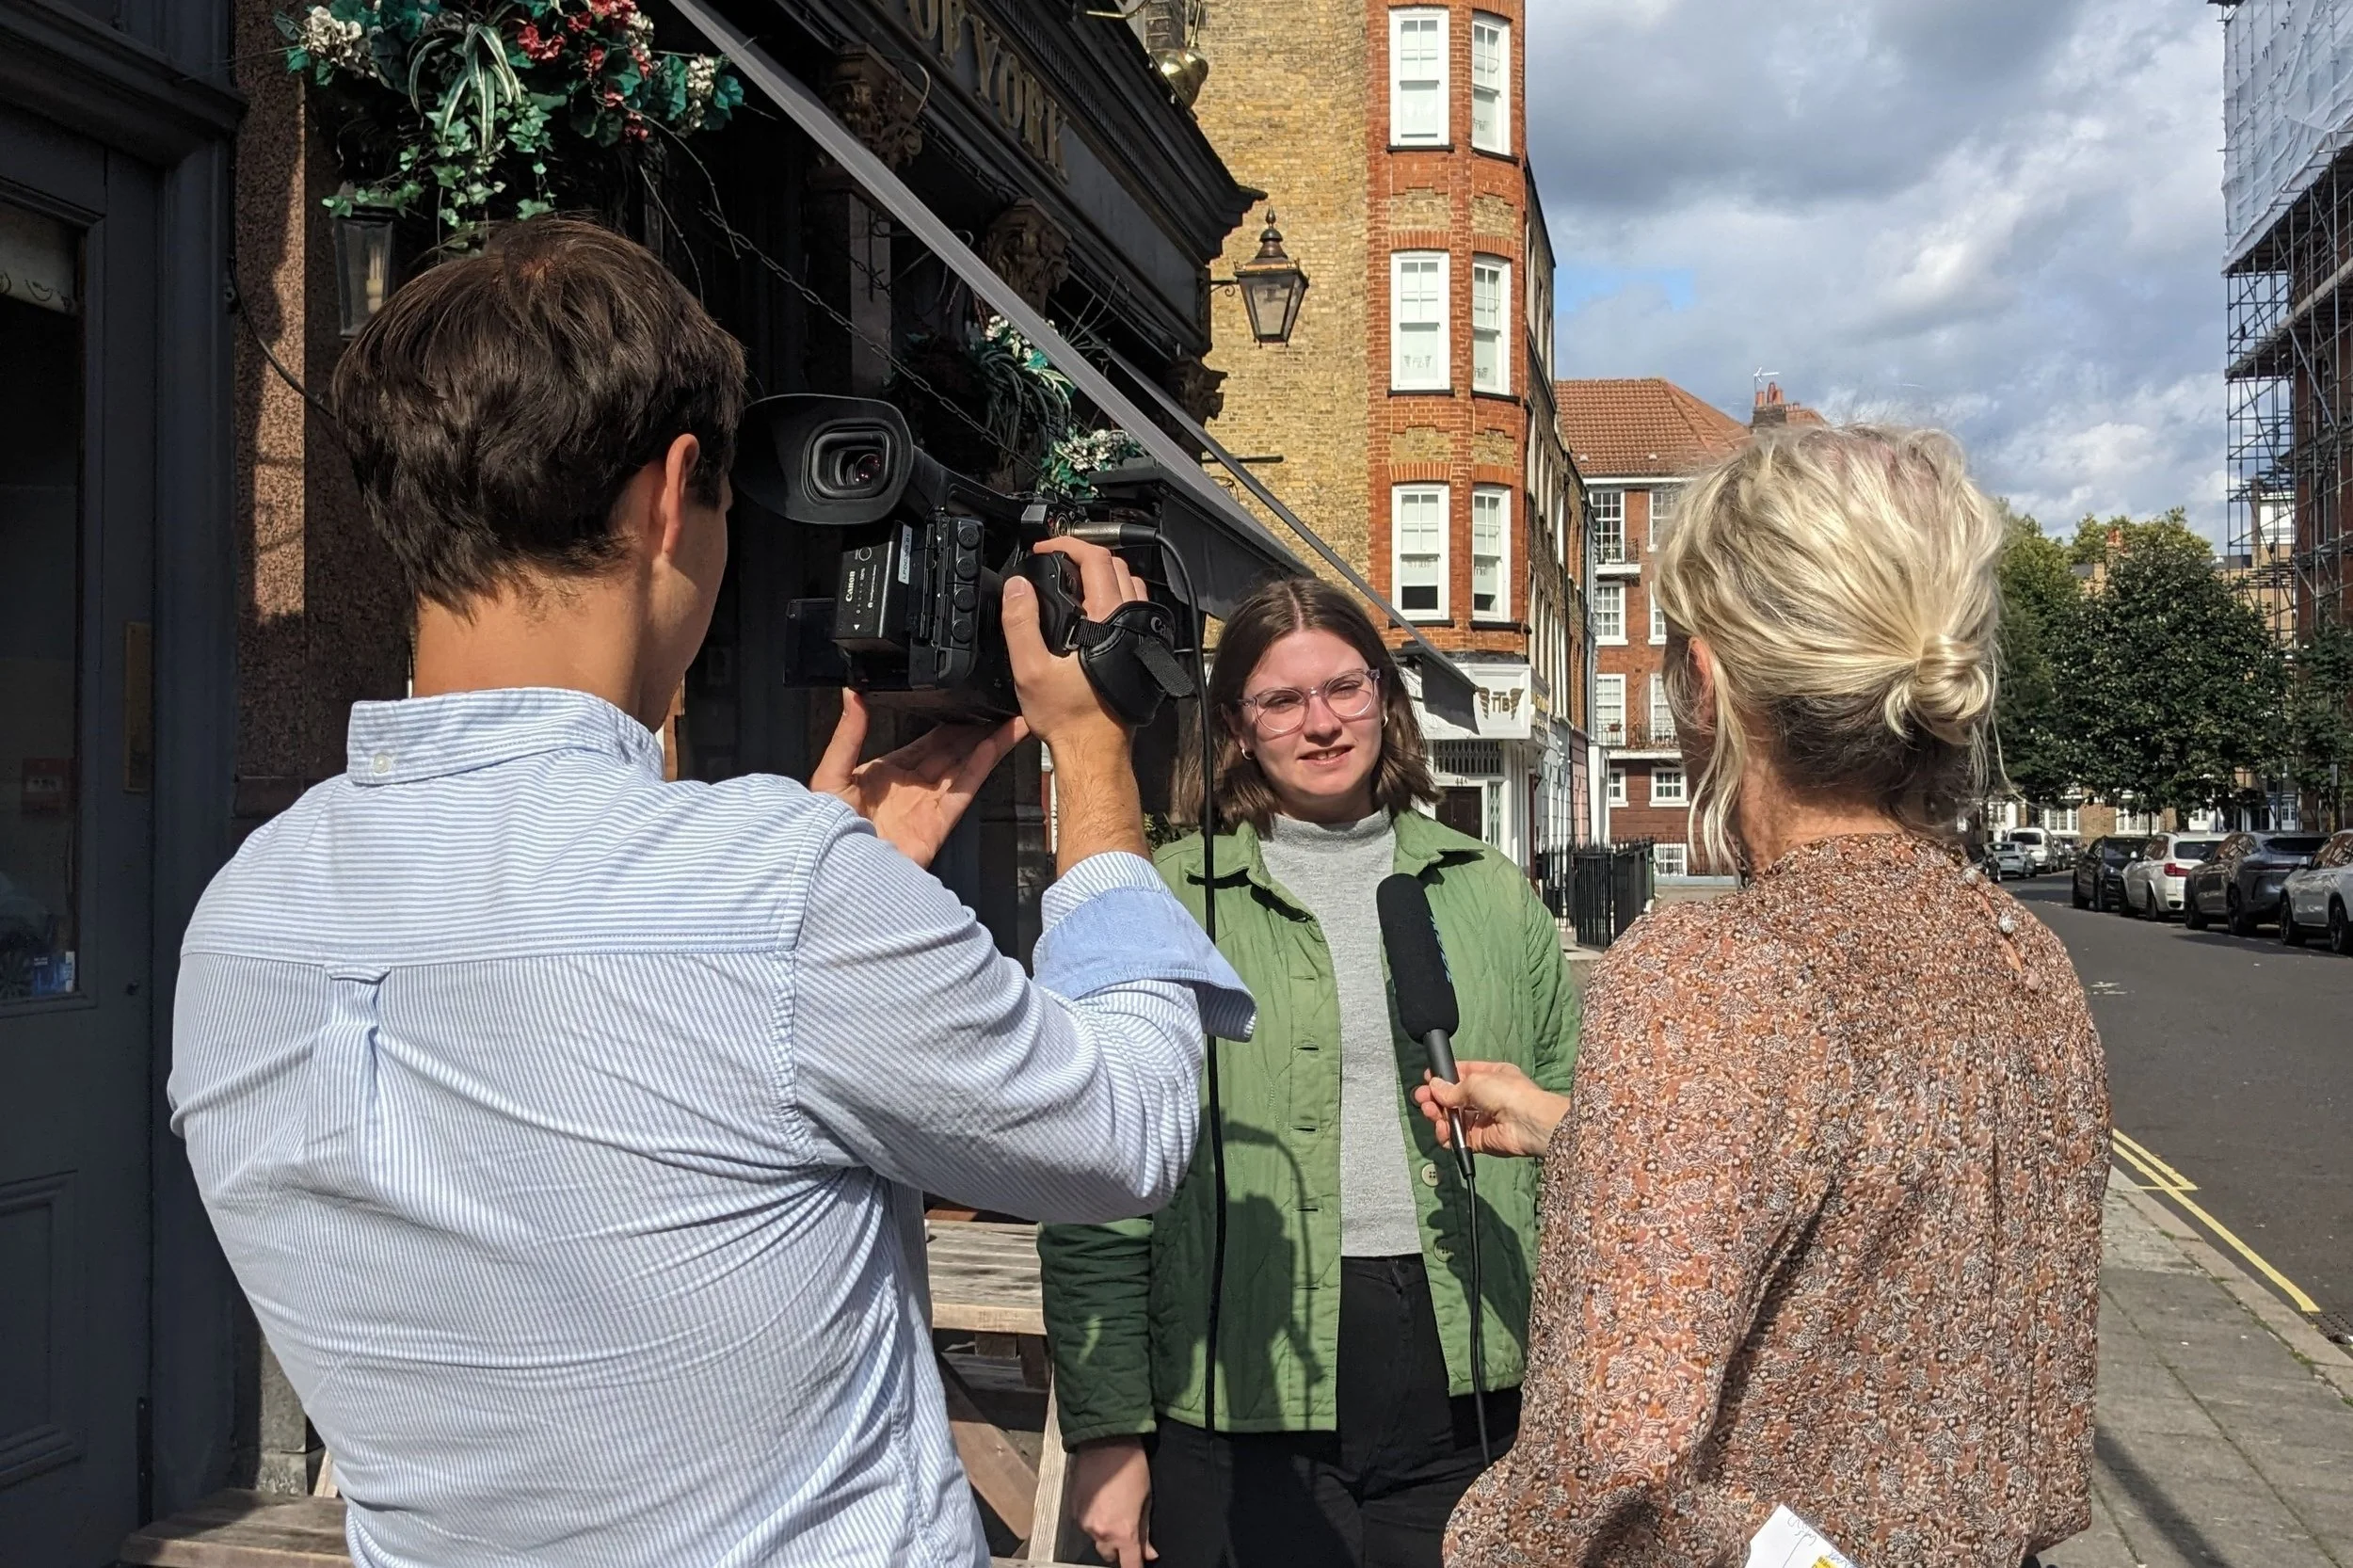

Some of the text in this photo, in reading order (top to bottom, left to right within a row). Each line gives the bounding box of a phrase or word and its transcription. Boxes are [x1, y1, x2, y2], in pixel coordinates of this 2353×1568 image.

[970, 13, 1069, 185] YORK
[845, 570, 856, 602] Canon
[1491, 691, 1511, 714] TTB
